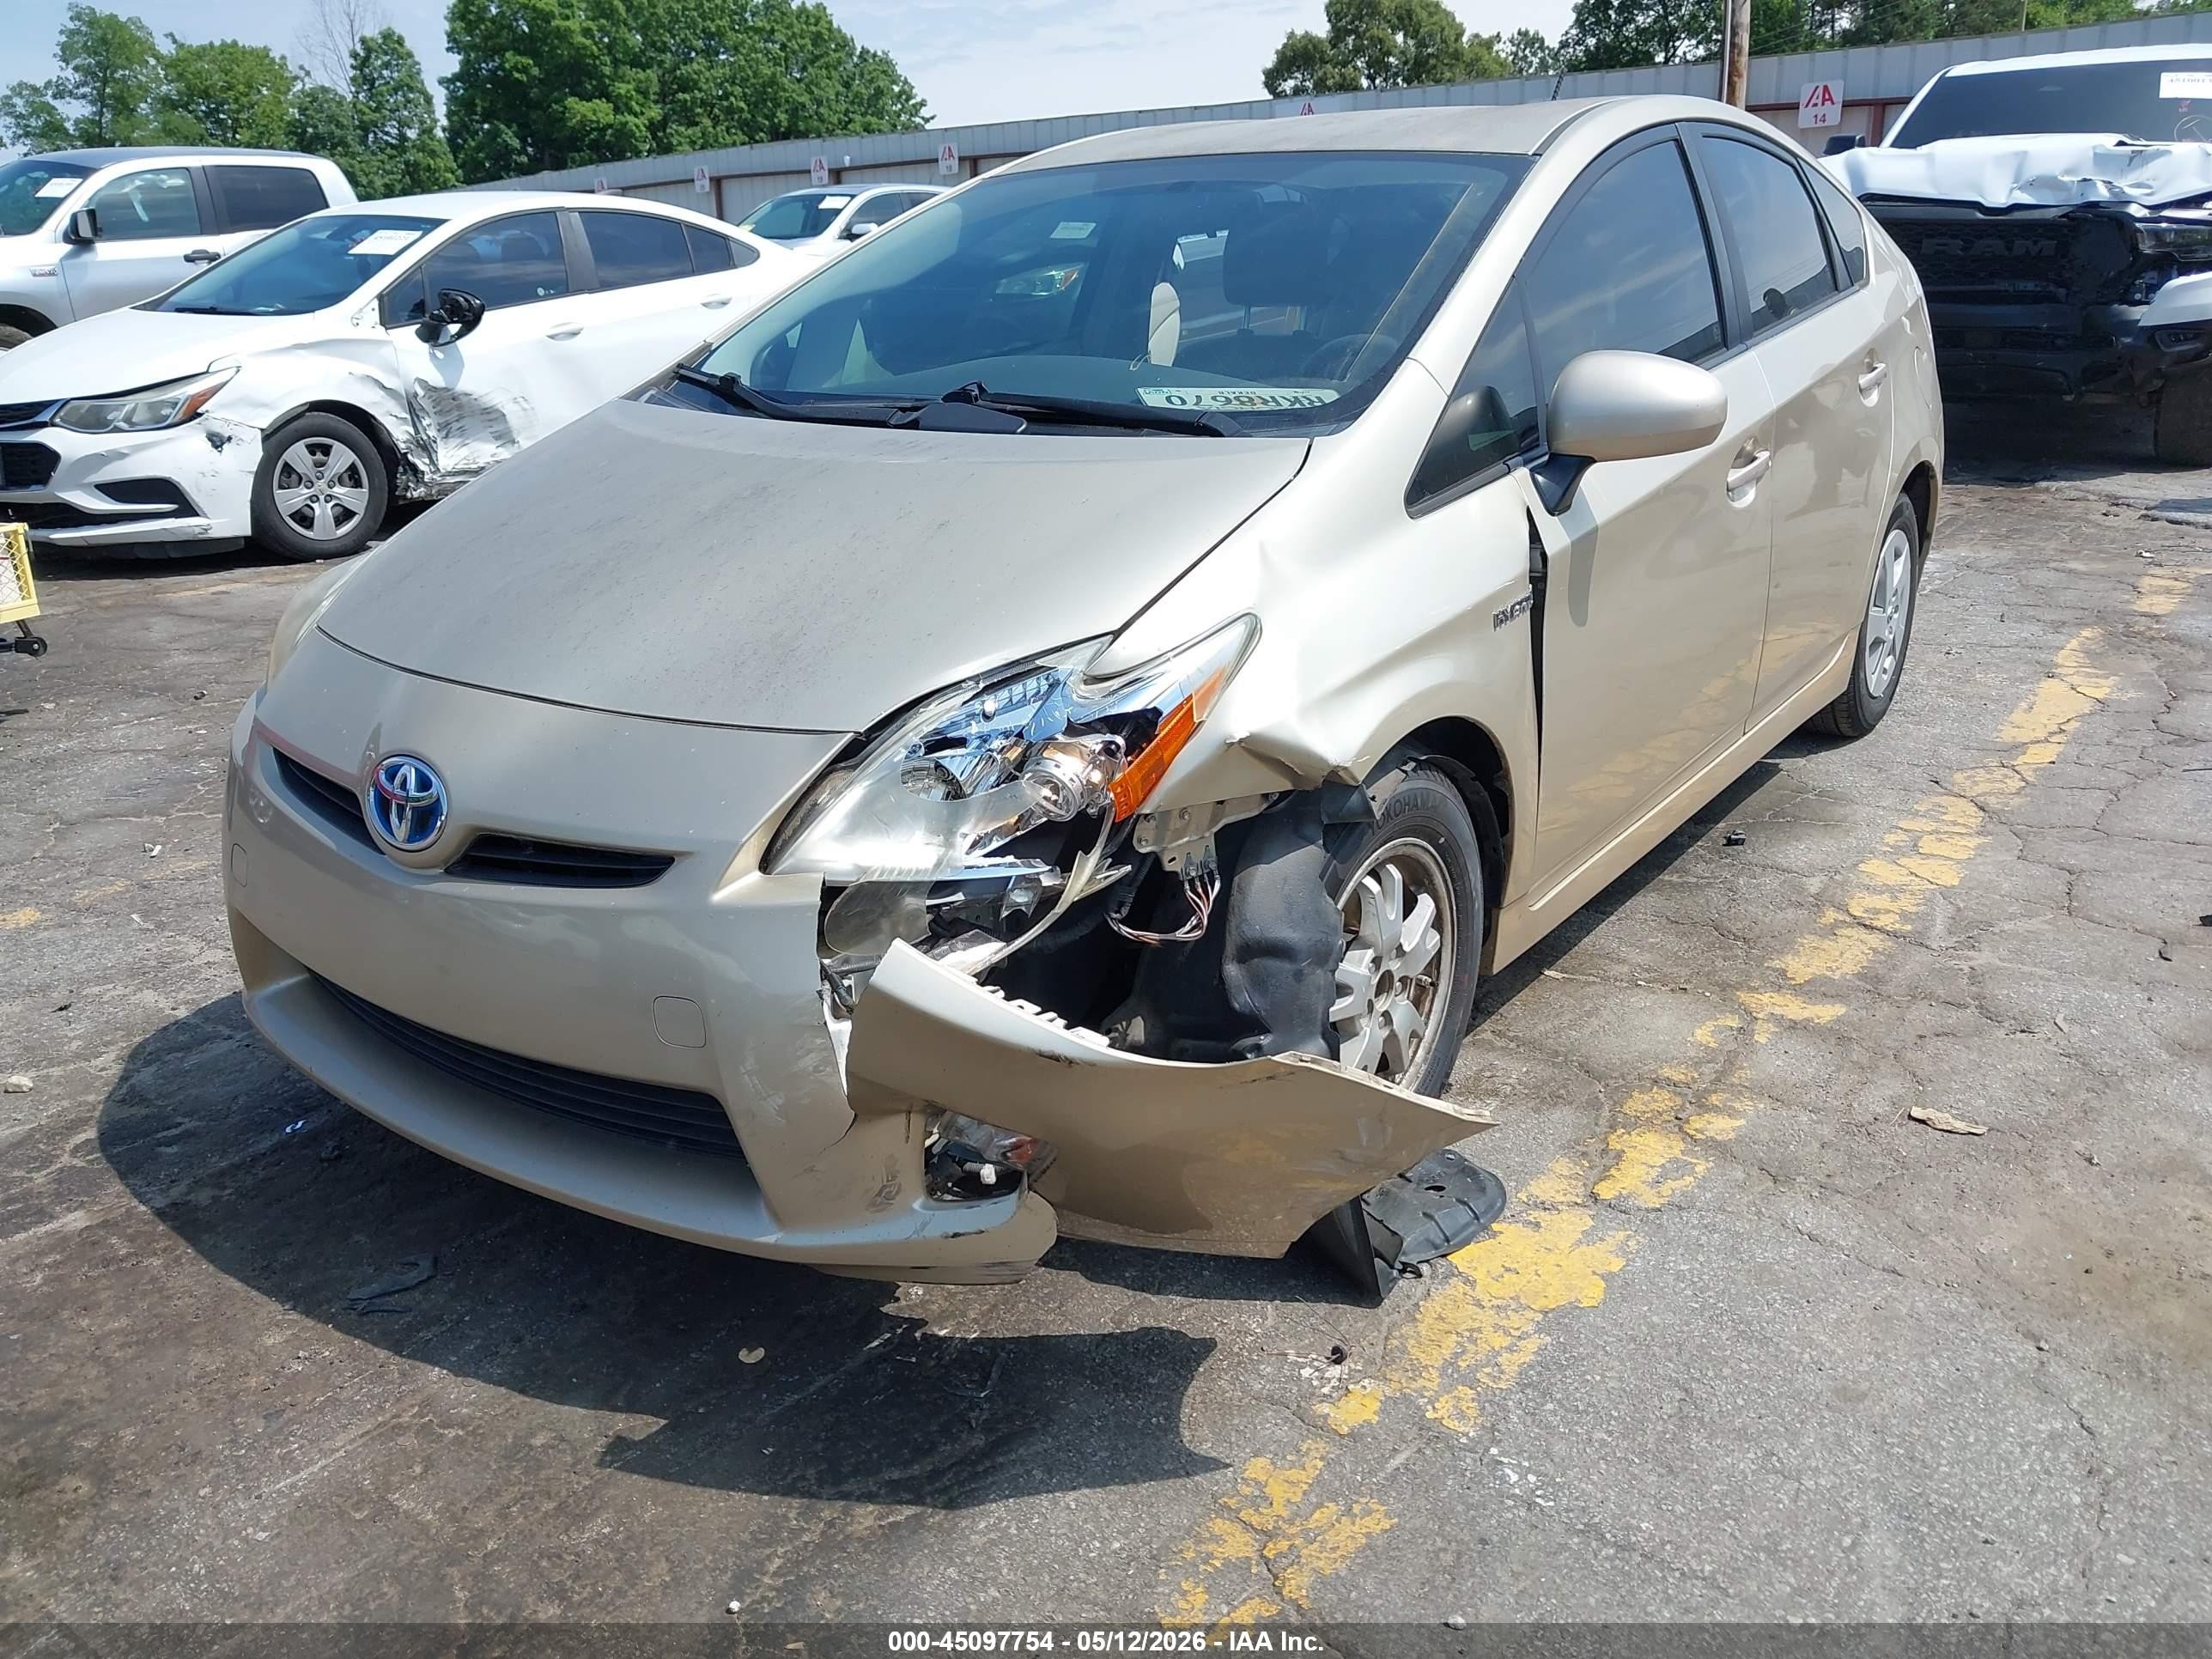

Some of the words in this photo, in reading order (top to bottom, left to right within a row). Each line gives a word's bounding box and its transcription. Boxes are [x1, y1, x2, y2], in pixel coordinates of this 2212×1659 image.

[1813, 112, 1827, 125] 14
[1919, 239, 2057, 256] RAM
[1164, 394, 1327, 407] RKR8670
